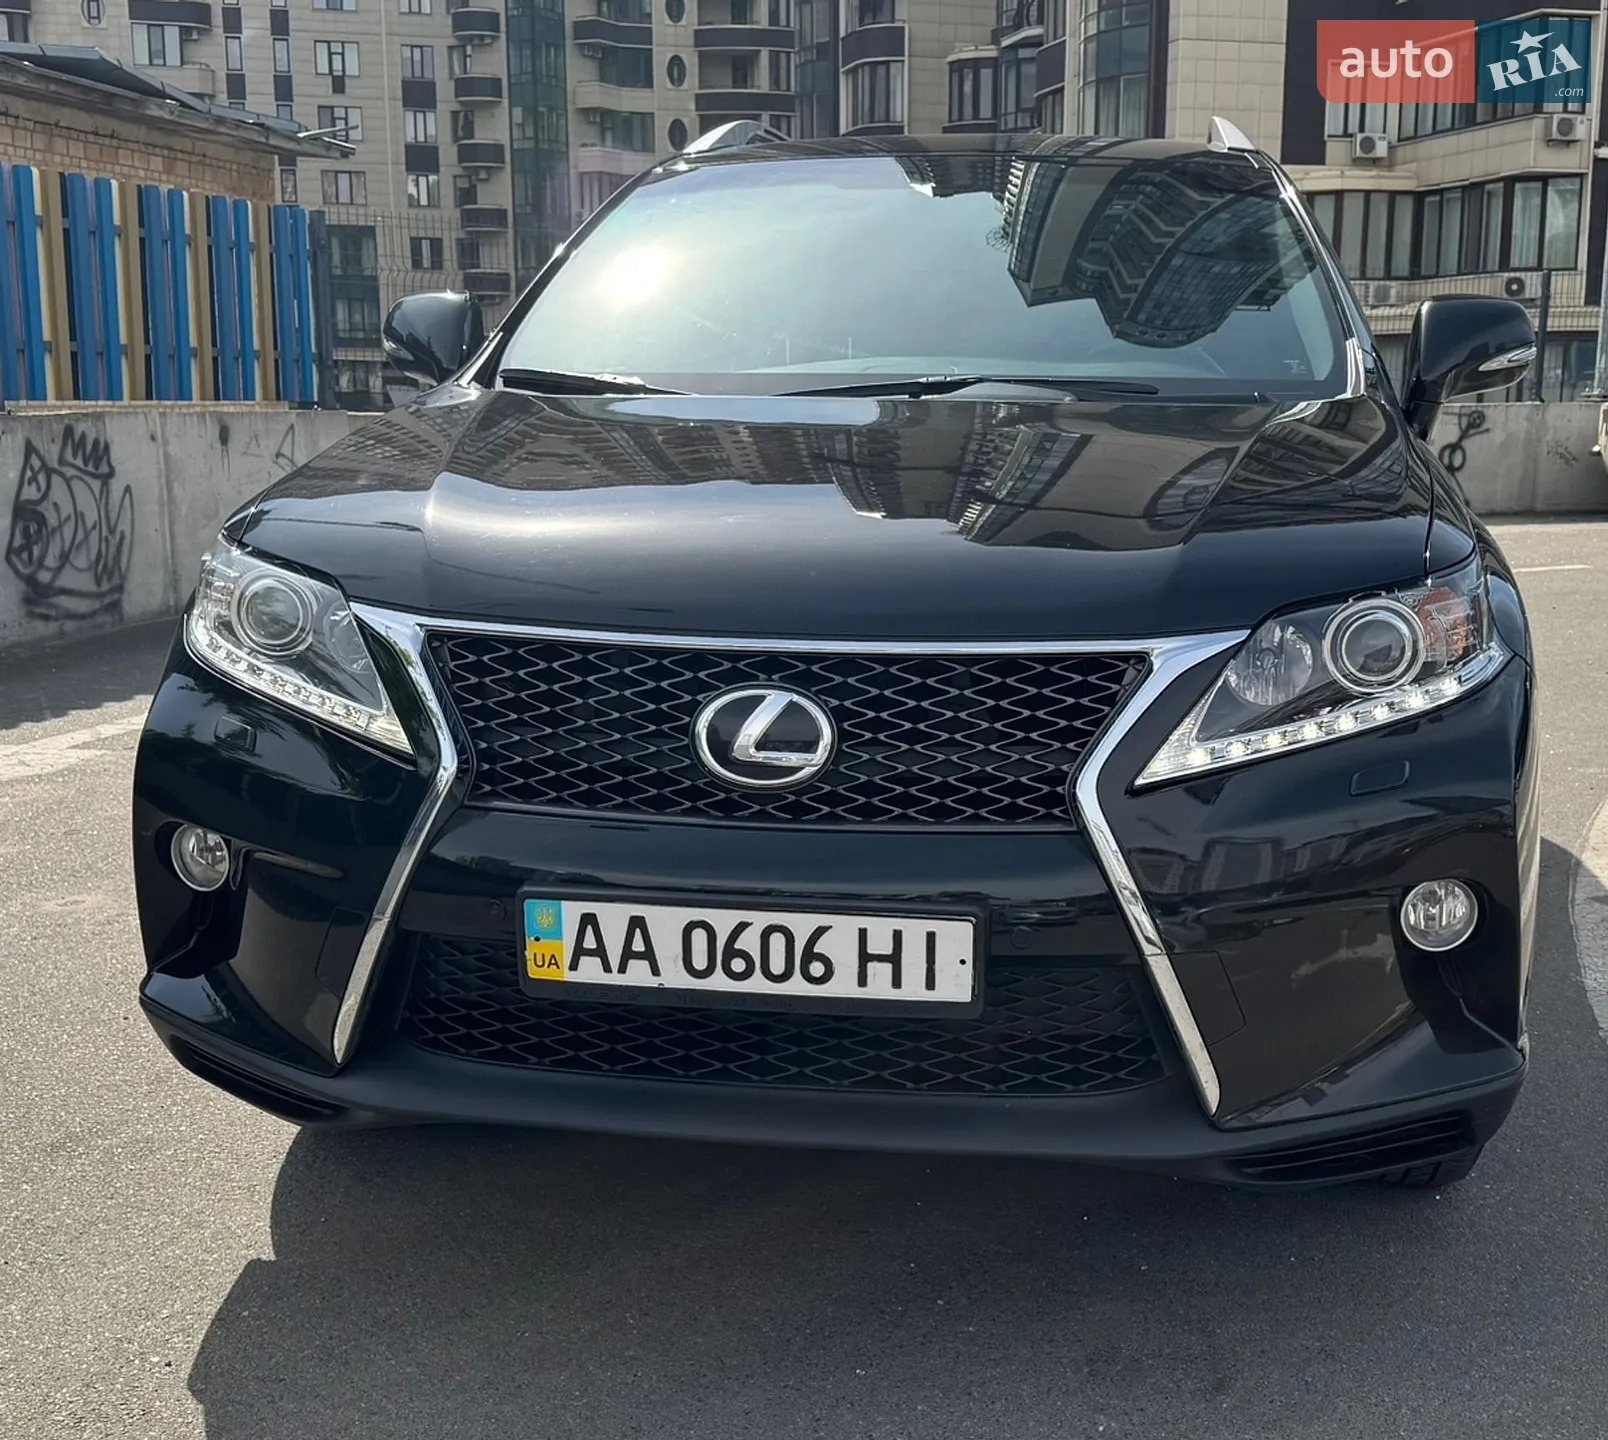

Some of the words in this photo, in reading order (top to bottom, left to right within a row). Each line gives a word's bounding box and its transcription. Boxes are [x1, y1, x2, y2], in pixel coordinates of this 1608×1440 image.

[533, 952, 560, 969] UA
[568, 912, 661, 977] AA
[682, 919, 835, 986] 0606
[857, 927, 936, 991] HI
